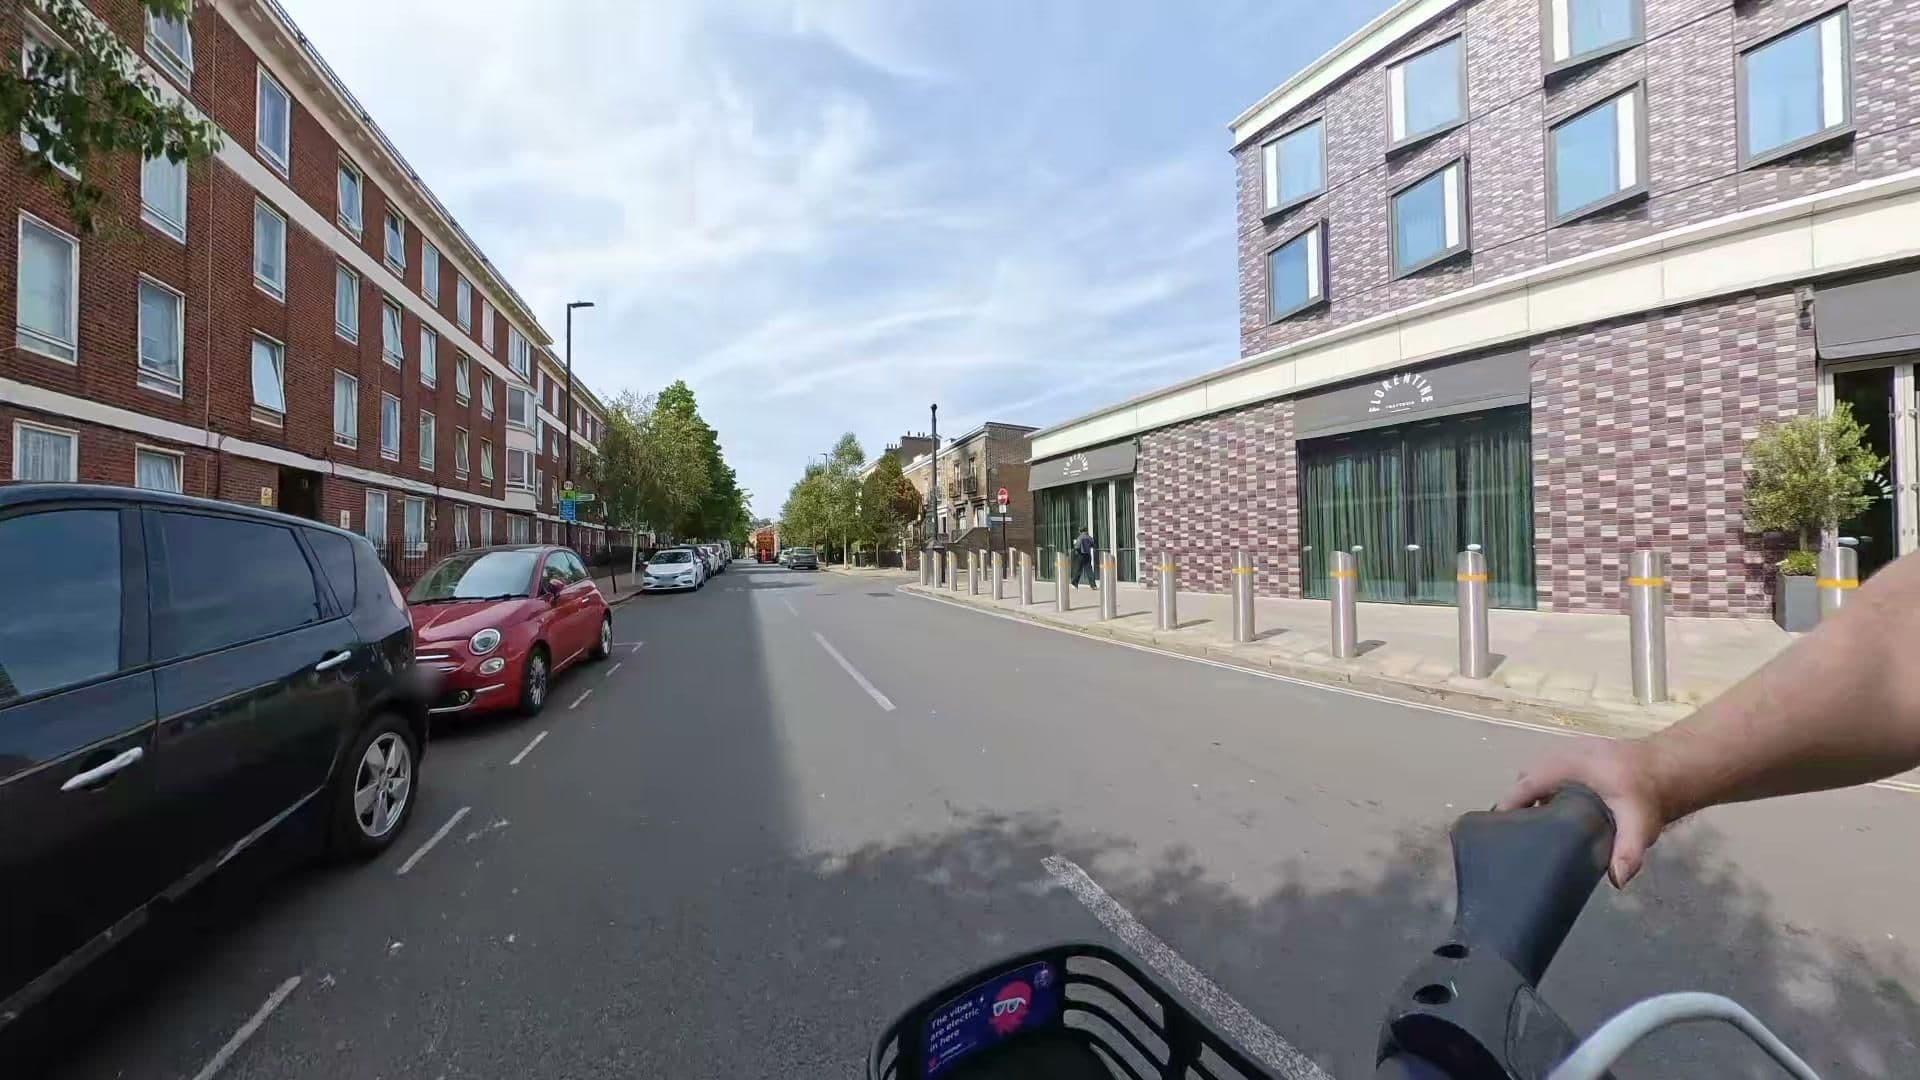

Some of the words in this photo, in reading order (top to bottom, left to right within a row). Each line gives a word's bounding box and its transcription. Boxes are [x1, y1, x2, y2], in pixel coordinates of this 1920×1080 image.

[1368, 373, 1433, 412] FLORENTINE
[930, 1028, 945, 1041] are
[946, 1008, 980, 1031] electric
[931, 1015, 948, 1030] The
[949, 1001, 973, 1017] vibes
[940, 1029, 960, 1047] here
